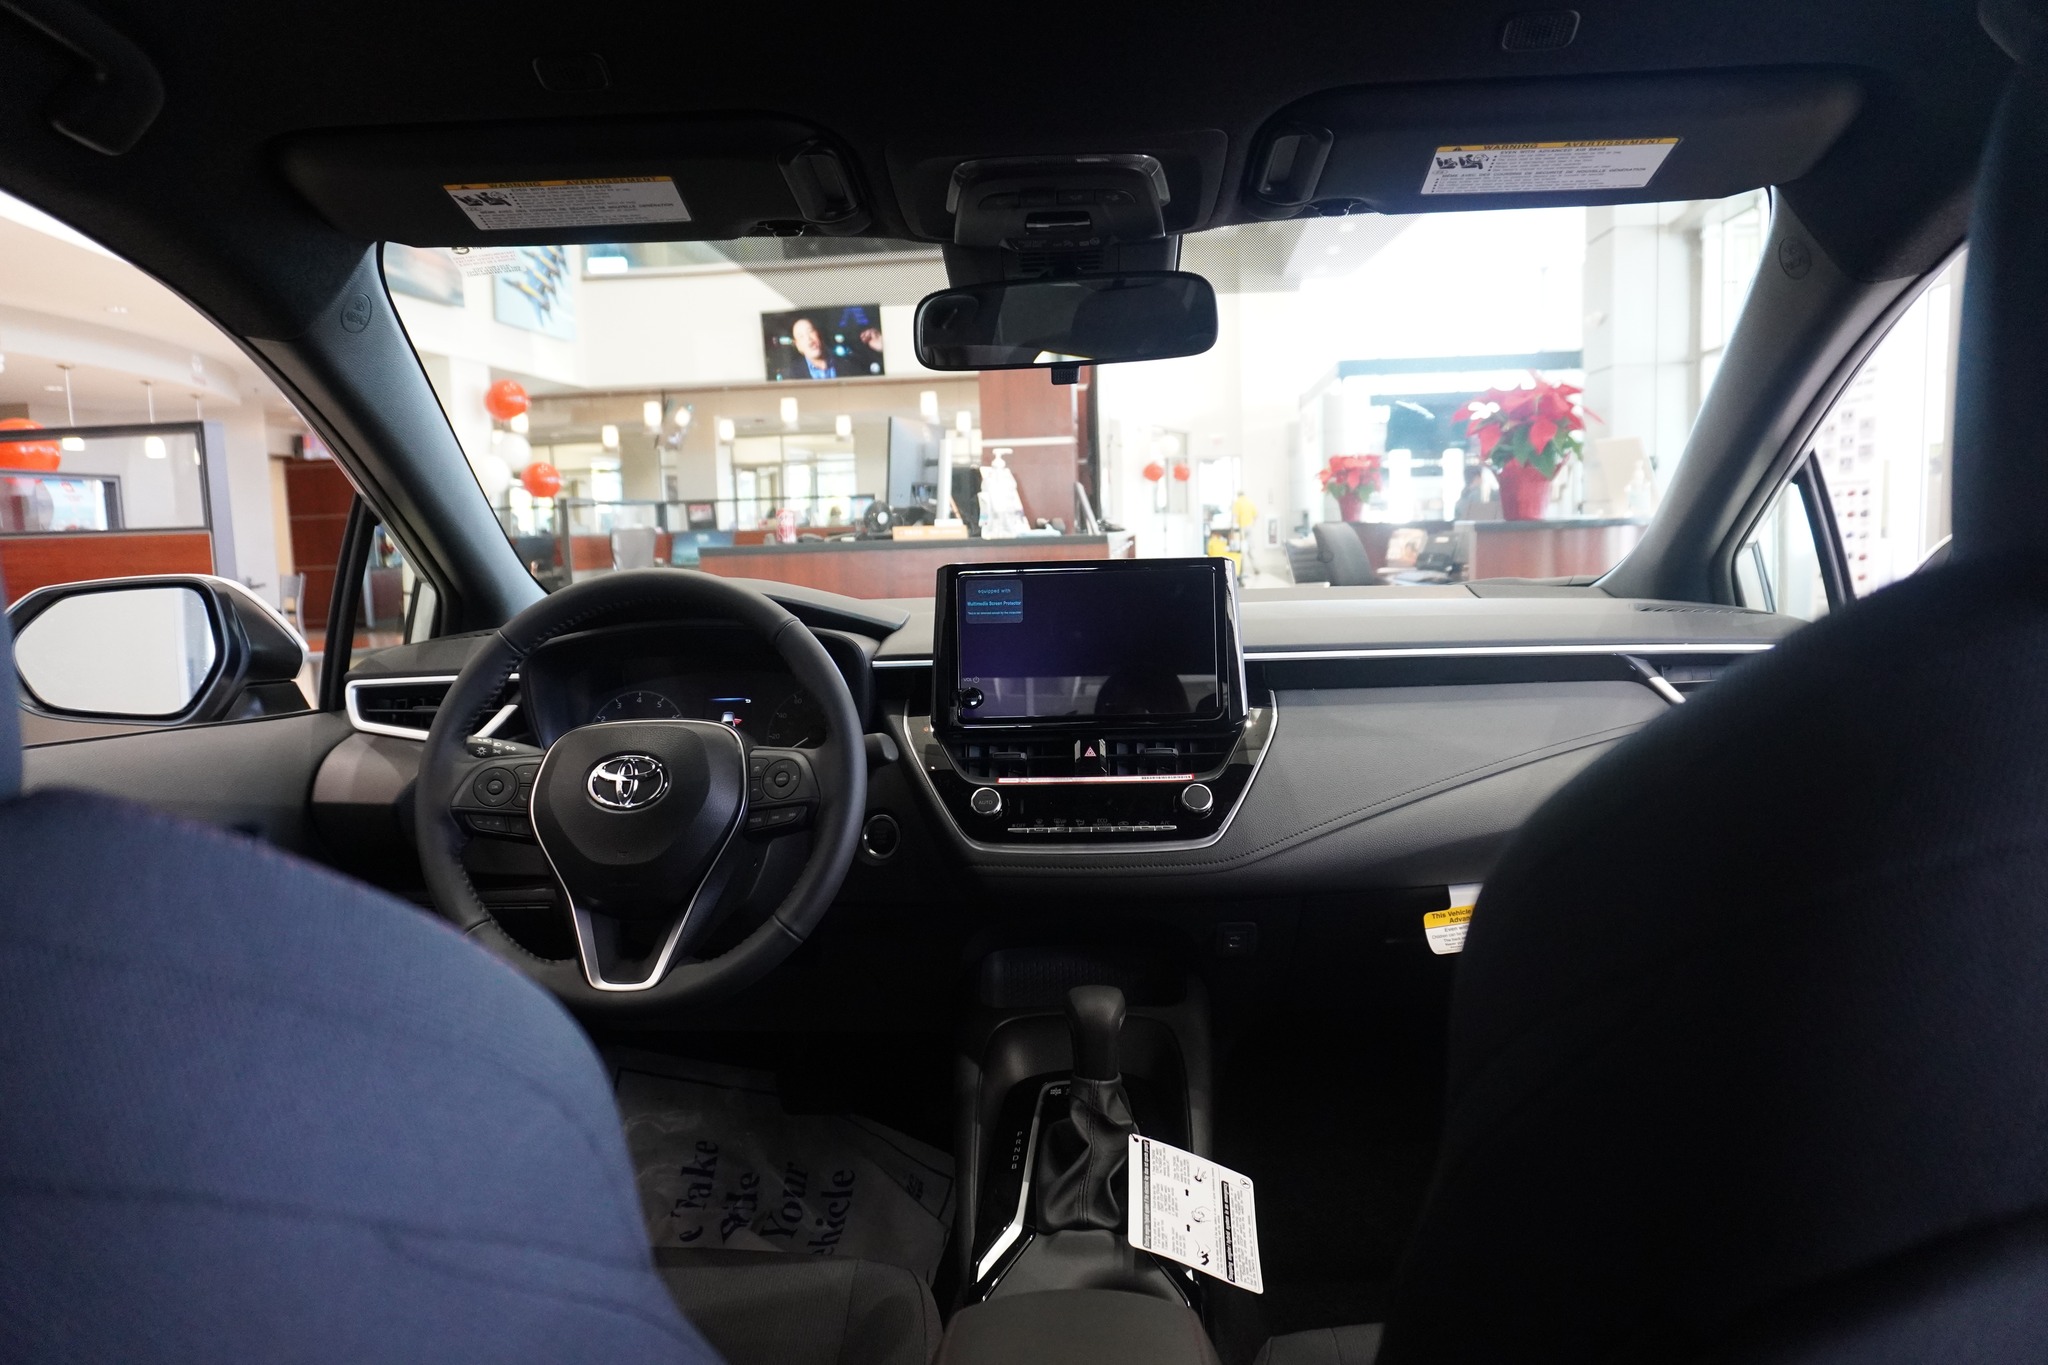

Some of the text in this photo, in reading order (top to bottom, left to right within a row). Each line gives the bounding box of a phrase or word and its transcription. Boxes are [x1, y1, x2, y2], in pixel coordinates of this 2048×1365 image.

[1483, 138, 1662, 151] WARNING AVERTISSEMENT
[565, 177, 658, 186] AVERTISSEMENT
[1448, 909, 1471, 917] Vehicle
[670, 1140, 718, 1218] Take
[760, 1162, 808, 1238] Your
